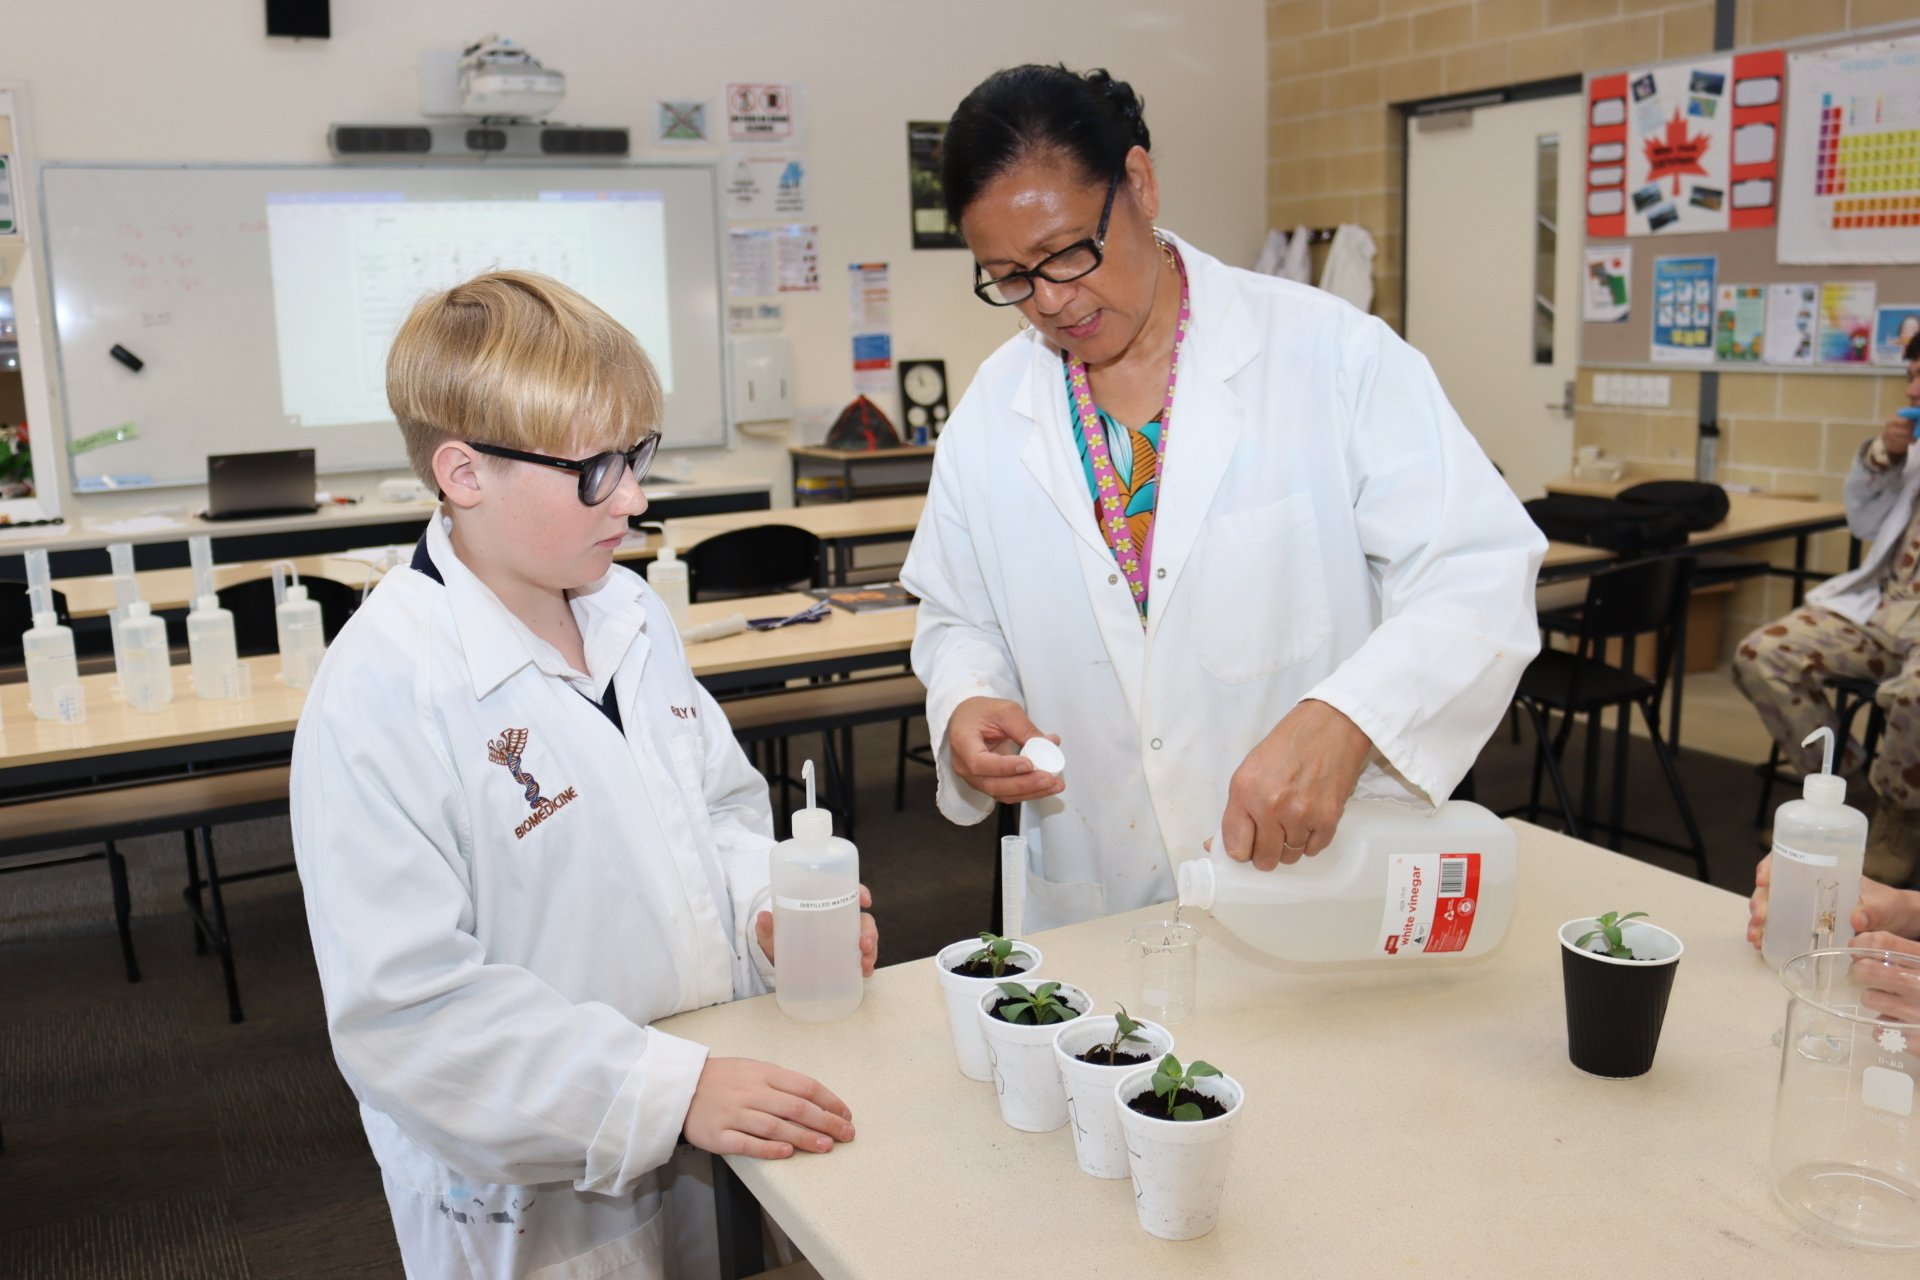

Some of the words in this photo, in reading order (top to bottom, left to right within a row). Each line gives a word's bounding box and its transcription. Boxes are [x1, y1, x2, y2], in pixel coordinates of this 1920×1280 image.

[514, 786, 578, 840] BIOMEDICINE
[831, 897, 849, 905] WATER
[1401, 916, 1415, 946] white
[1408, 866, 1422, 913] vinegar
